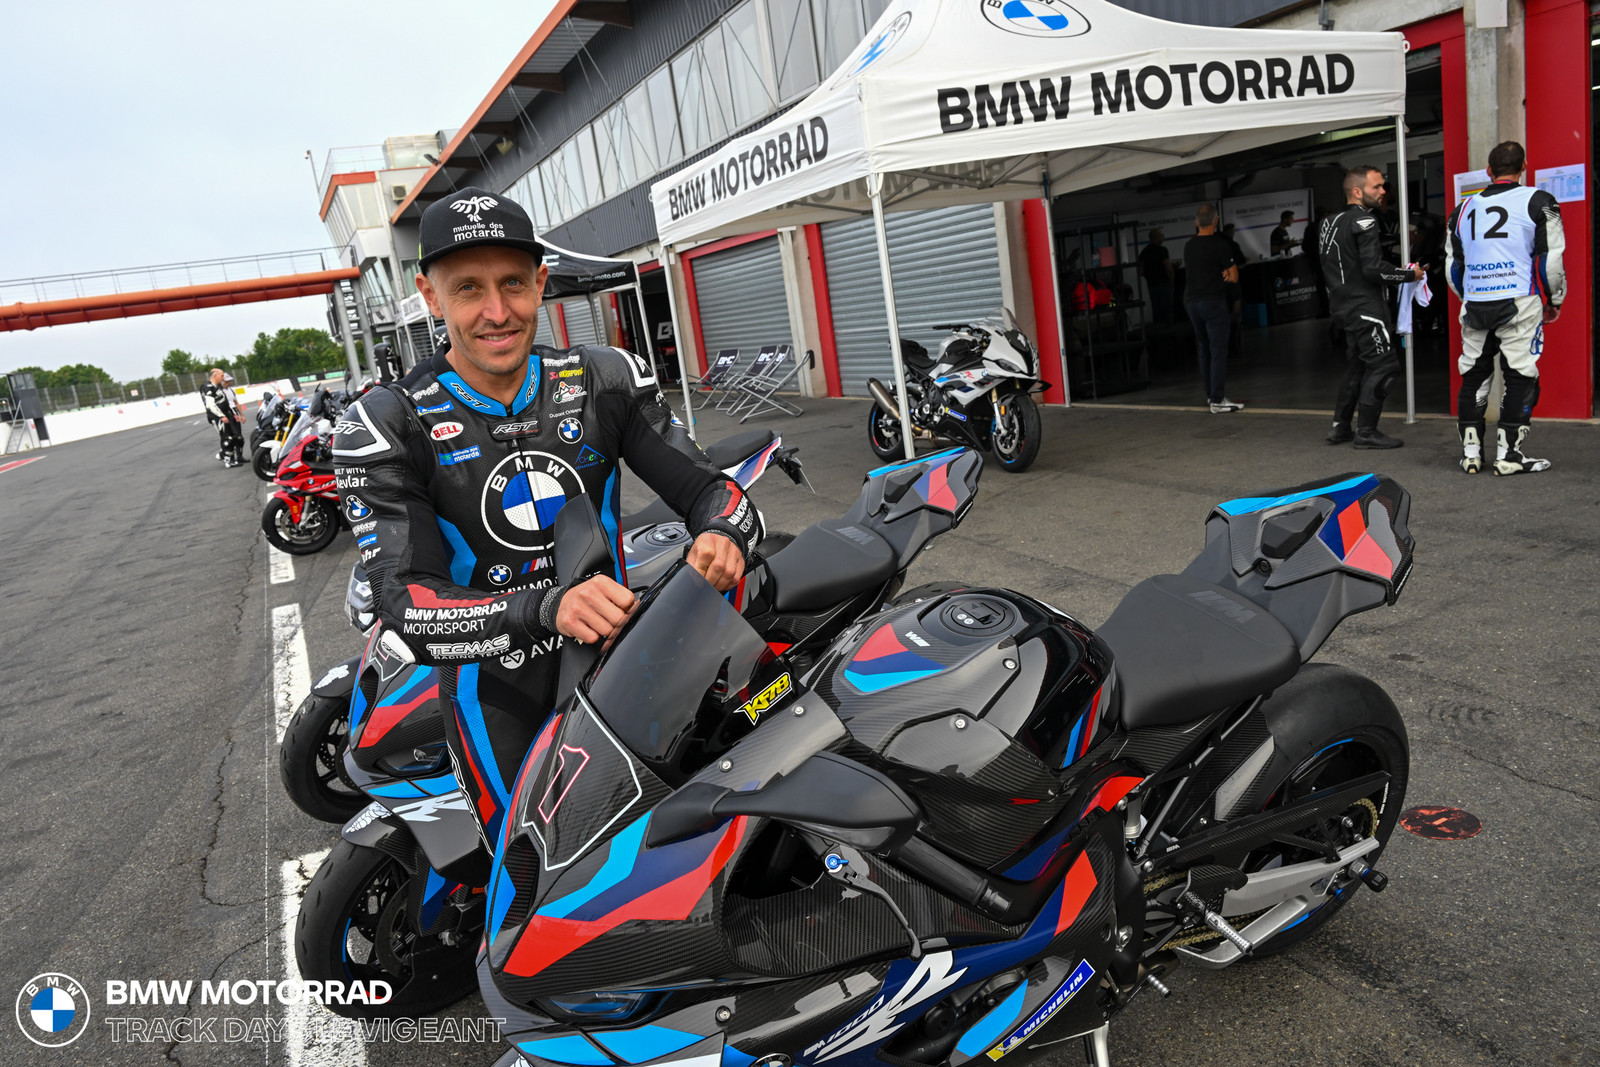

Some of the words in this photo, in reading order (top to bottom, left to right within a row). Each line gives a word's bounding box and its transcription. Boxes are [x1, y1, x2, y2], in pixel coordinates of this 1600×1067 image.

[938, 75, 1072, 134] BMW
[1090, 53, 1355, 115] MOTORRAD
[668, 173, 706, 221] BMW
[711, 116, 829, 203] MOTORRAD
[453, 222, 486, 233] mutuelle
[1467, 206, 1508, 241] 12
[454, 228, 505, 242] motards
[1482, 271, 1517, 279] MOTORRAD
[1475, 284, 1517, 292] MICHELIN
[526, 363, 537, 404] RST
[450, 383, 491, 408] RST
[433, 424, 461, 439] BELL
[493, 420, 539, 435] RST
[346, 467, 366, 475] WITH
[490, 456, 566, 492] BMW
[404, 607, 437, 621] BMW
[437, 601, 508, 620] MOTORRAD
[403, 618, 486, 635] MOTORSPORT
[426, 633, 511, 657] TECMAS
[481, 648, 510, 658] TEAM
[742, 674, 790, 721] KF78
[1023, 972, 1084, 1036] MICHELIN
